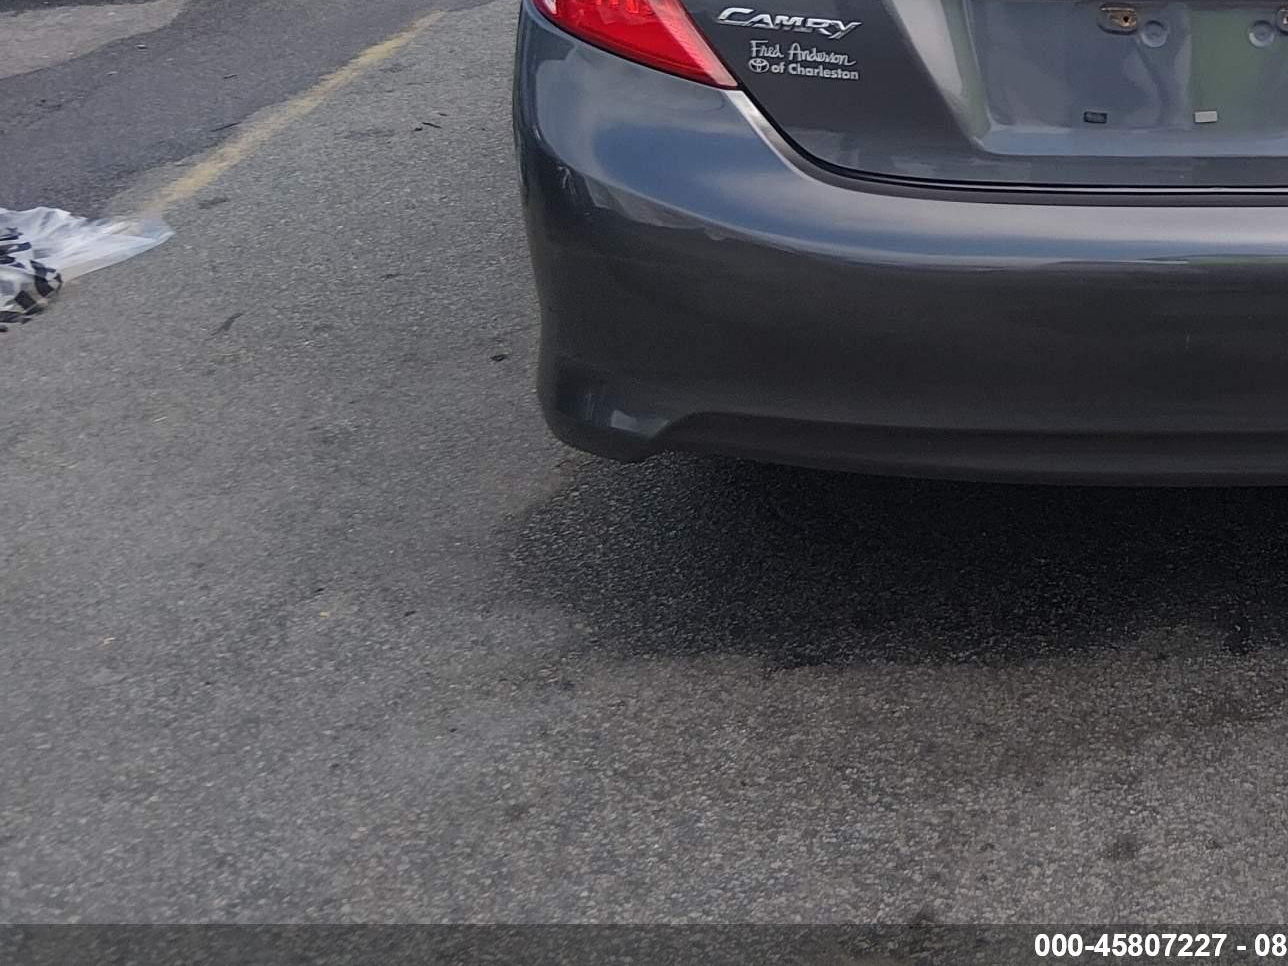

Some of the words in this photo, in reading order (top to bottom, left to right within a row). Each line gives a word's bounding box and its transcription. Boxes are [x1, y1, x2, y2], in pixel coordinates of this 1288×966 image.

[716, 7, 862, 40] CAMRY
[749, 40, 785, 58] Fred
[787, 42, 857, 66] Anderson
[770, 61, 786, 74] of
[788, 63, 860, 80] Charleston
